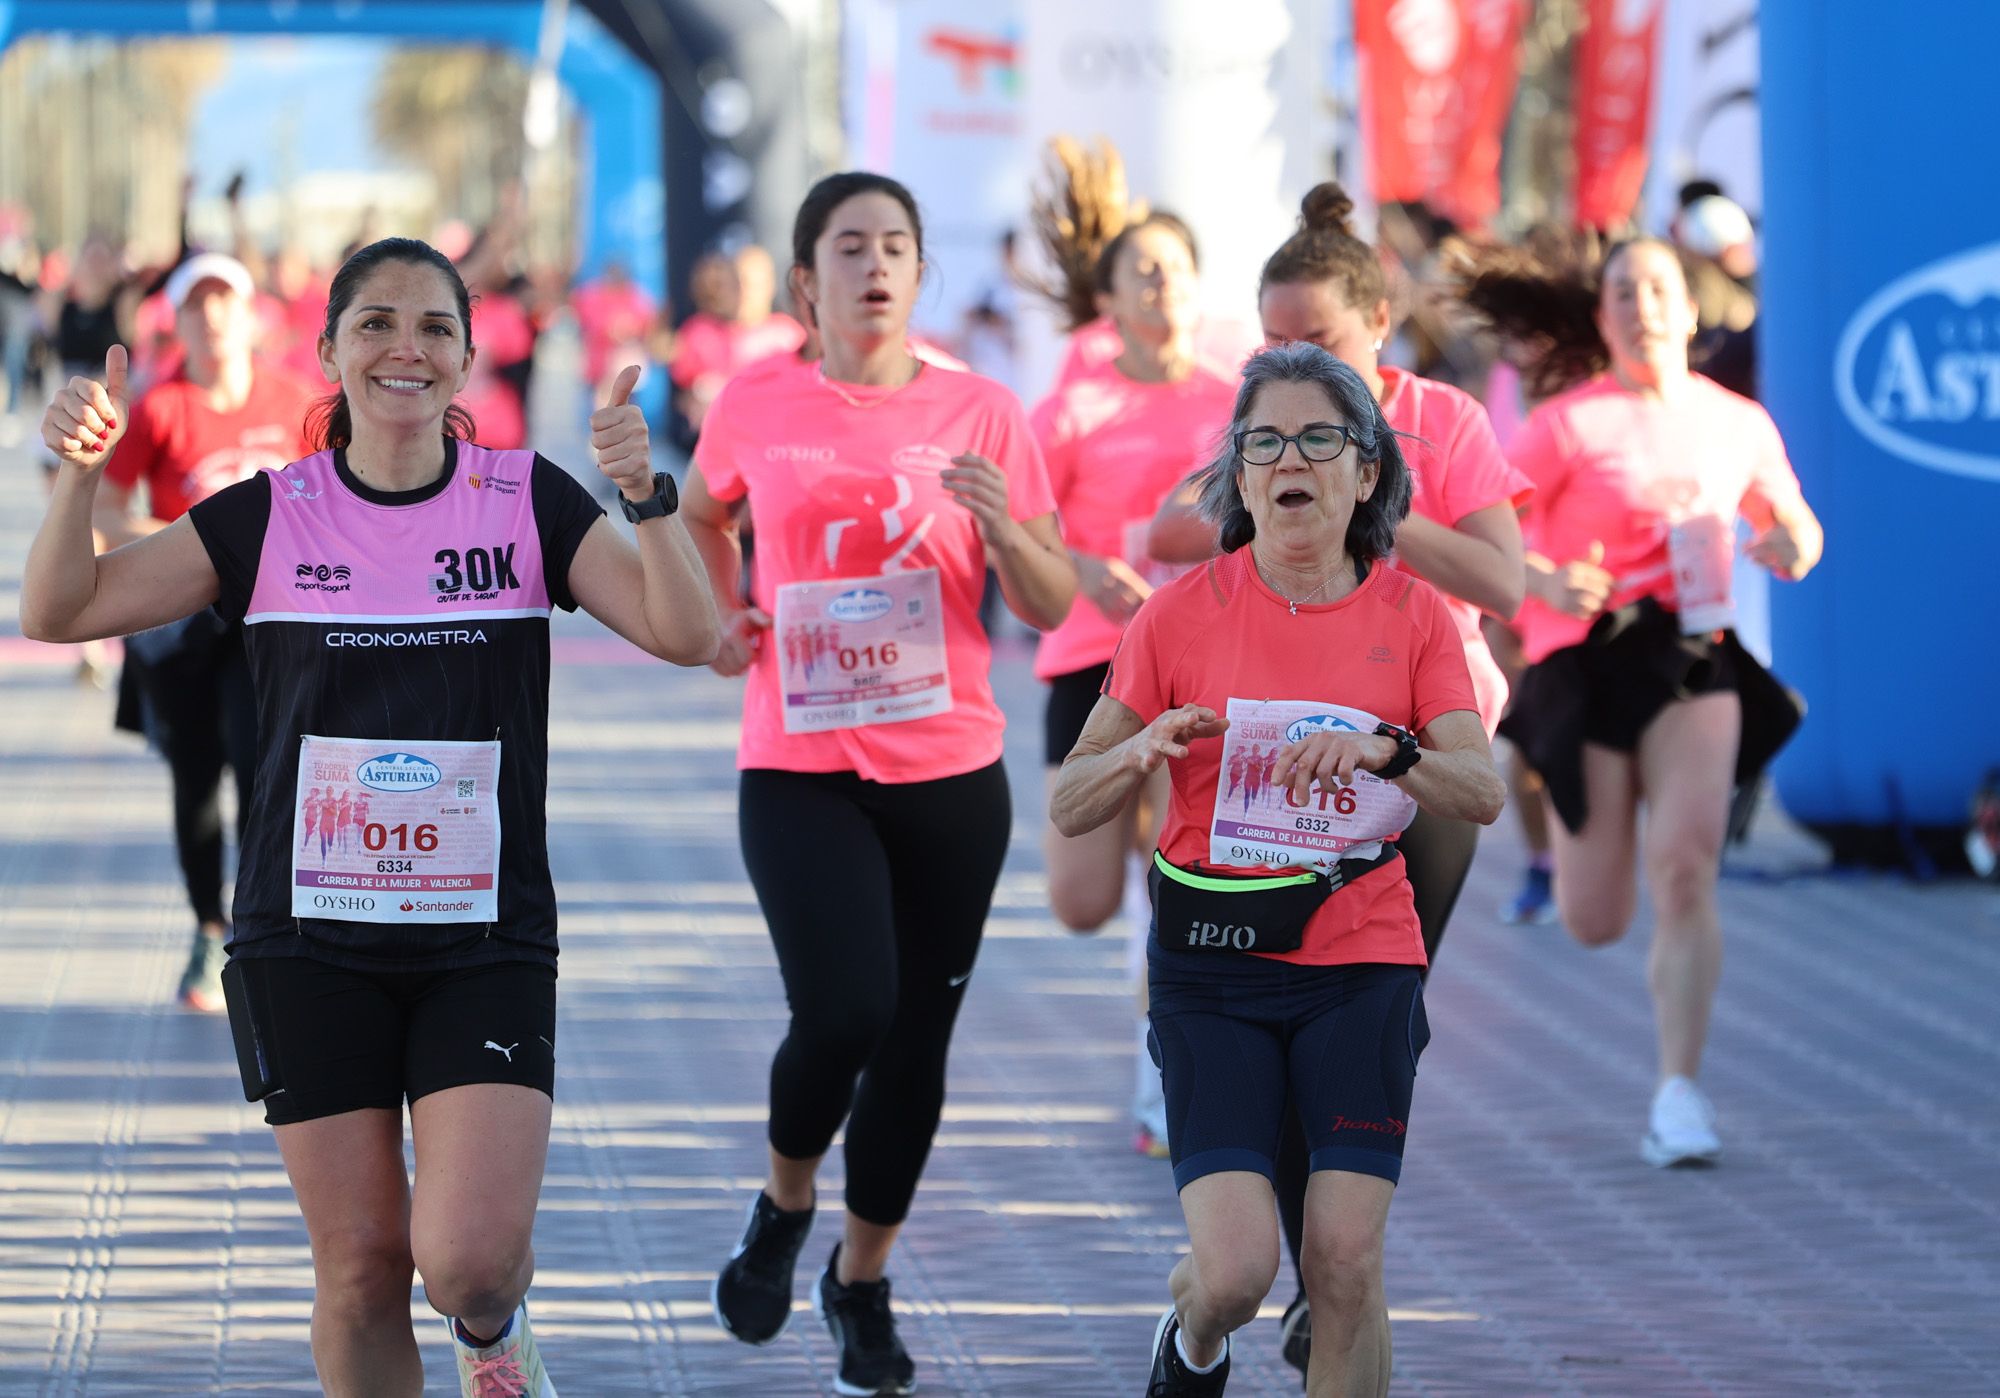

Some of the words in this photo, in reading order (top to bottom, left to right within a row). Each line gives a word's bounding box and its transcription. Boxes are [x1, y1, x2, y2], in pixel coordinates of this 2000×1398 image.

[434, 542, 520, 593] 30K
[462, 593, 472, 601] DE
[325, 628, 488, 648] CRONOMETRA
[838, 641, 899, 672] 016
[1241, 728, 1278, 740] SUMA
[314, 769, 350, 783] SUMA
[363, 769, 435, 783] ASTURIANA
[1295, 817, 1330, 833] 6332
[363, 823, 439, 852] 016
[1236, 826, 1276, 841] CARRERA
[1278, 832, 1291, 843] DE
[1292, 835, 1303, 844] LA
[1306, 837, 1337, 849] MUJER
[1231, 845, 1290, 866] OYSHO
[377, 860, 413, 873] 6334
[317, 875, 359, 887] CARRERA
[361, 877, 373, 887] DE
[375, 878, 387, 888] LA
[390, 879, 421, 888] MUJER
[430, 878, 472, 888] VALENCIA
[314, 894, 376, 911] OYSHO
[415, 901, 474, 912] Santander
